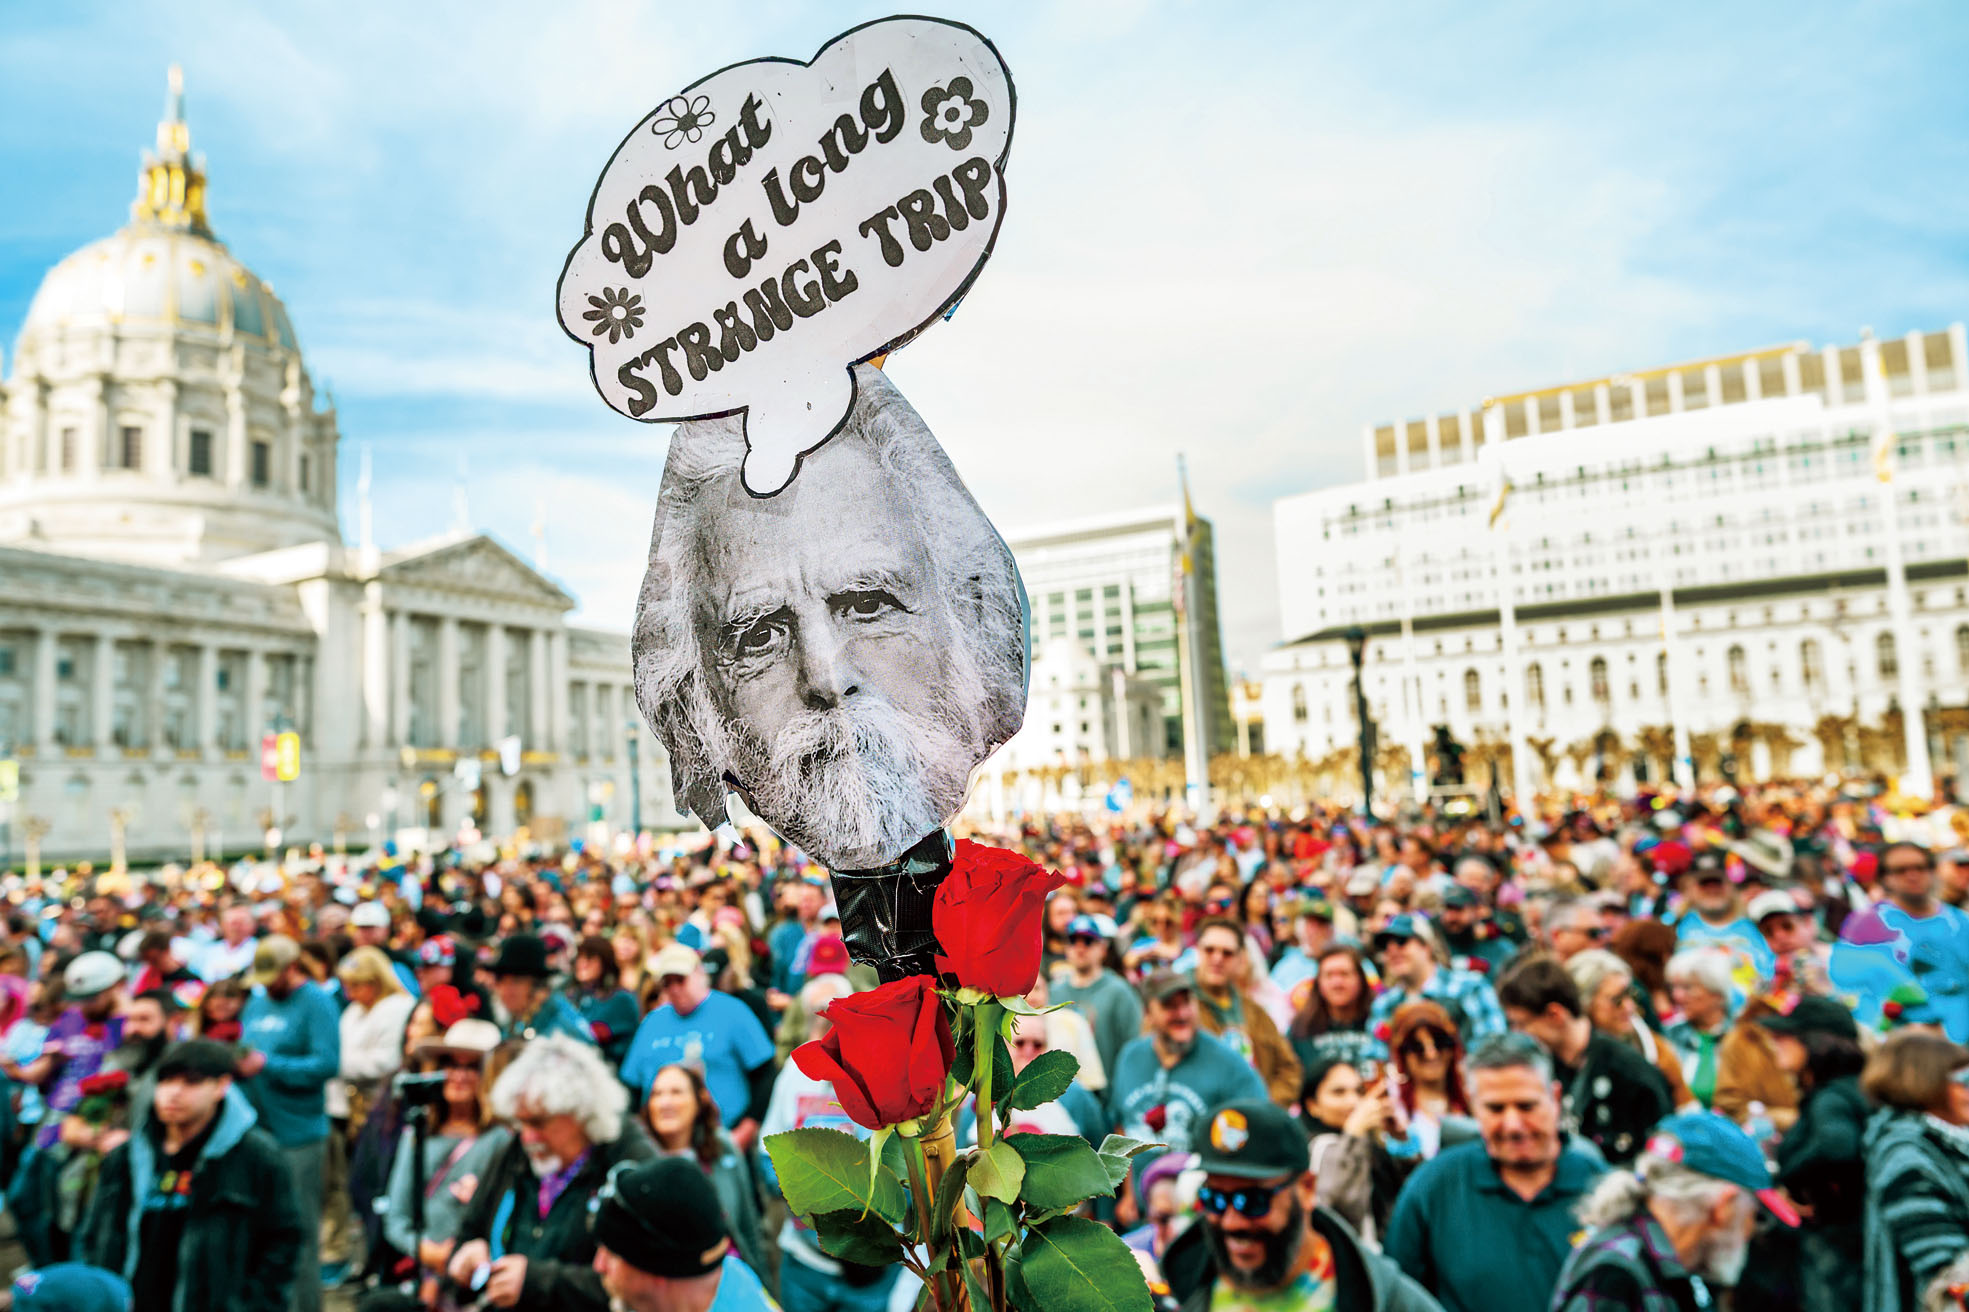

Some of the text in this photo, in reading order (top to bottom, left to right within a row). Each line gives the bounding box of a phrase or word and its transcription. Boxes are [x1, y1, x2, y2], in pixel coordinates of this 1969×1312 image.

[602, 92, 772, 279] What
[723, 68, 906, 279] a long
[617, 157, 992, 417] STRANGE TRIP
